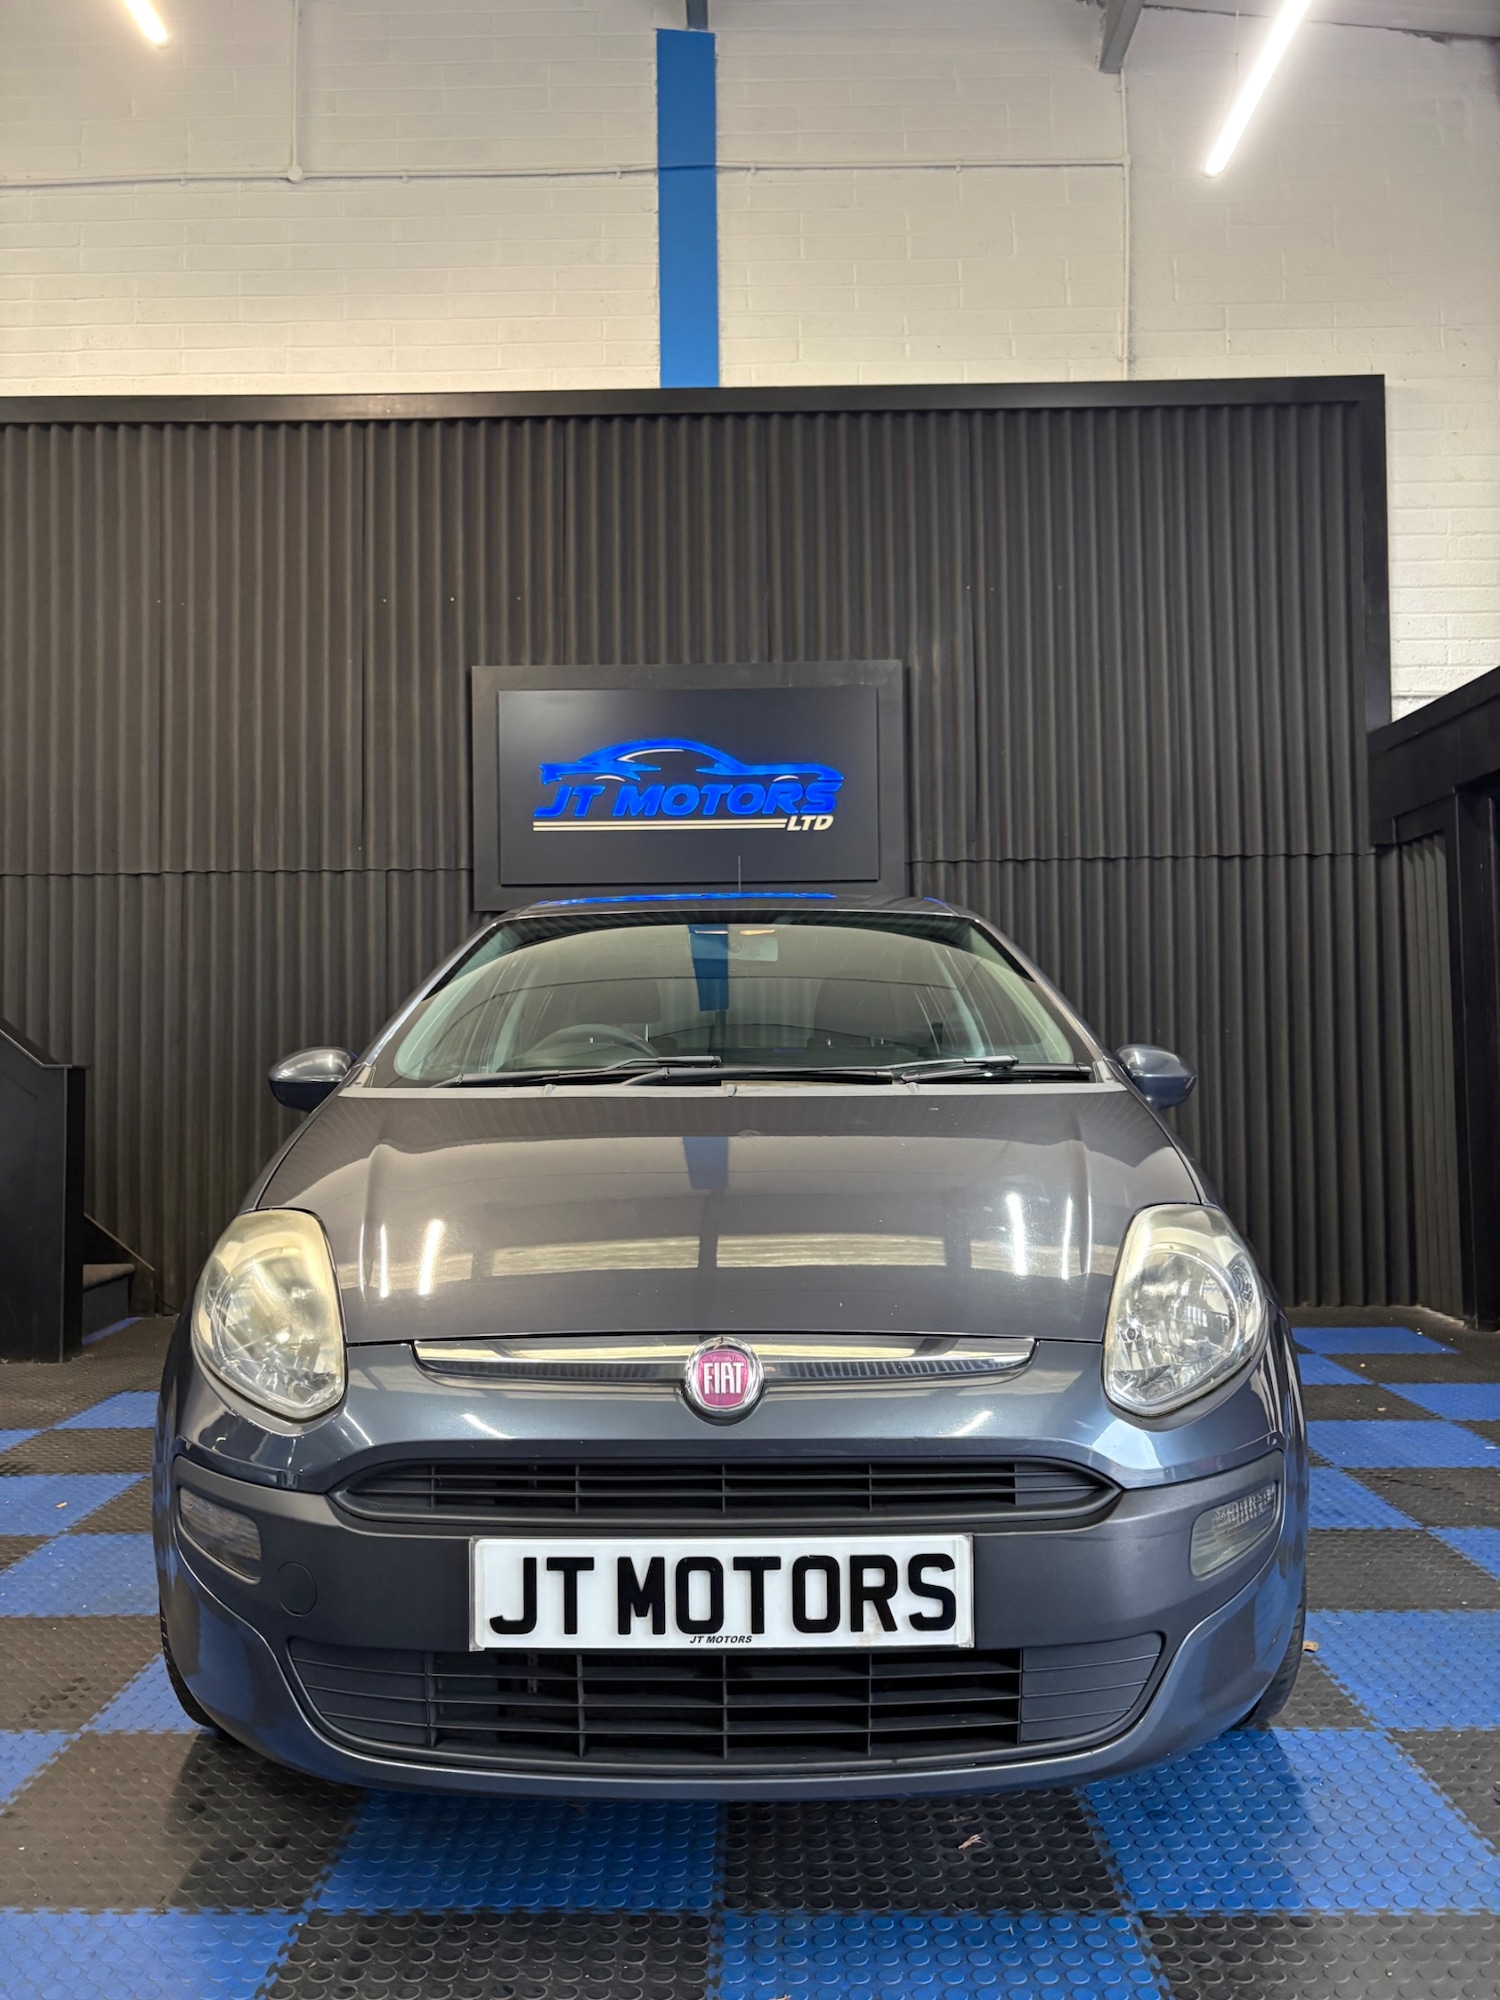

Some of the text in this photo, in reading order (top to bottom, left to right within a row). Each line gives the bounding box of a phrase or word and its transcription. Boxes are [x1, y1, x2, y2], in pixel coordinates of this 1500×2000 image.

[533, 783, 841, 817] JT MOTORS
[787, 816, 834, 831] LTD
[703, 1362, 744, 1394] FIAT
[489, 1553, 957, 1635] JT MOTORS
[689, 1635, 752, 1644] JT MOTORS
